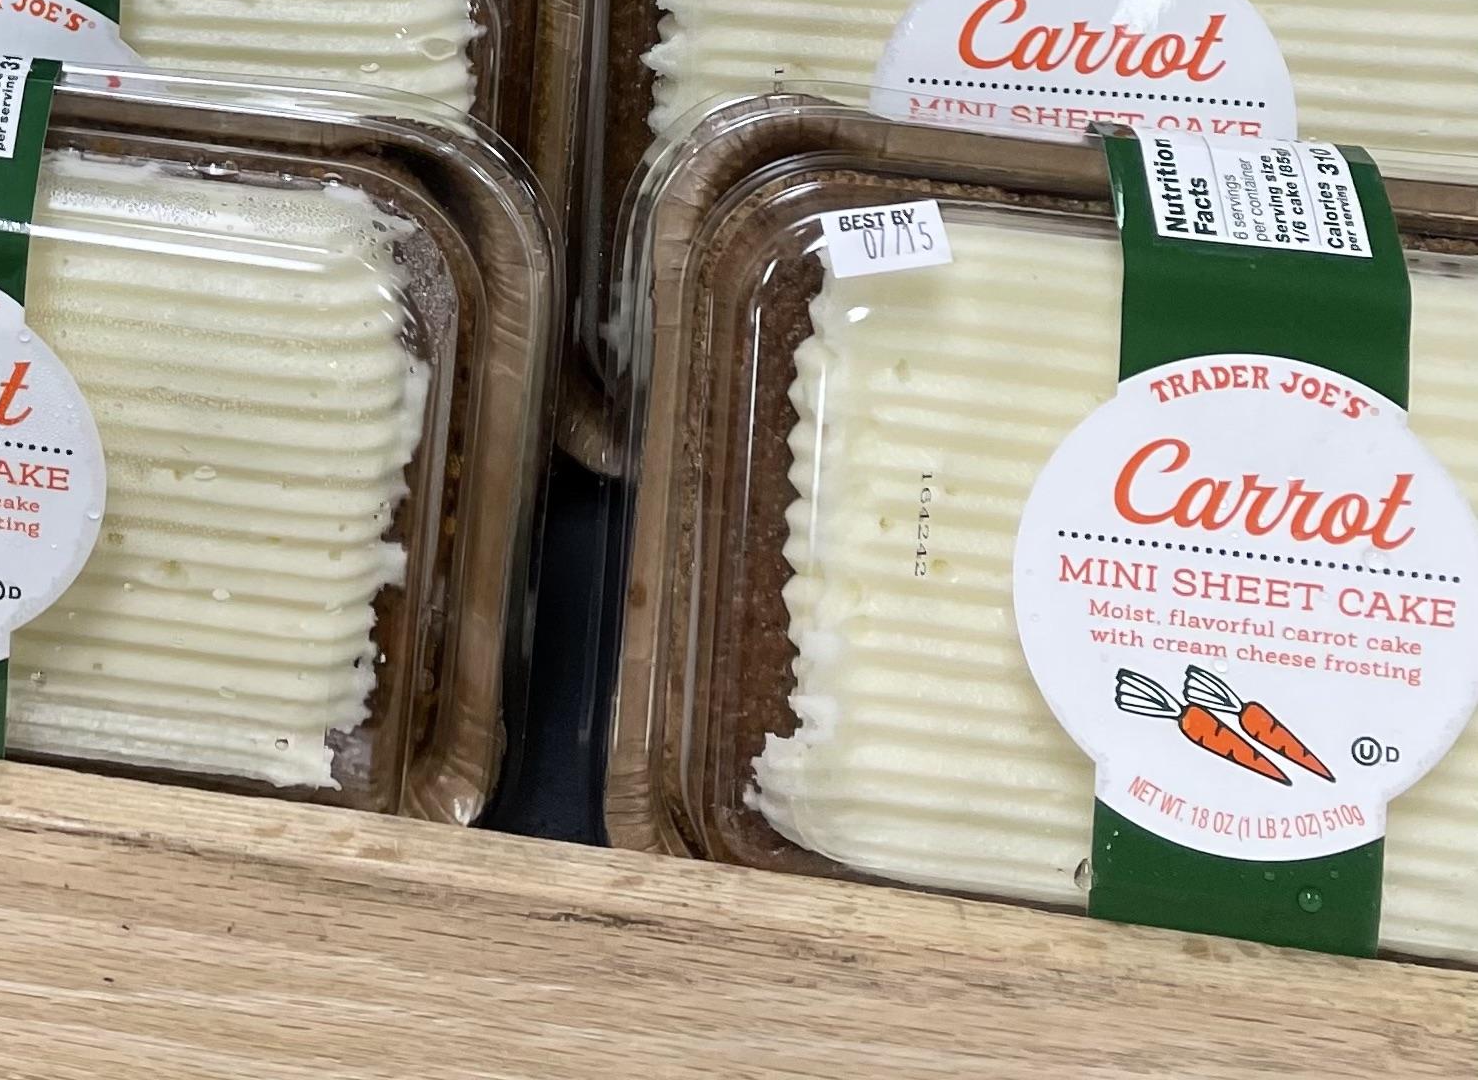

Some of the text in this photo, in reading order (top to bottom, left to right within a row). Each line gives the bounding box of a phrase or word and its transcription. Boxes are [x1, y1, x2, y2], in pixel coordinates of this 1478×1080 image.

[1155, 138, 1189, 234] Nutrition
[1190, 177, 1218, 237] Facts
[839, 208, 914, 232] BEST BY
[1150, 365, 1371, 420] TRADER JOE'S
[1113, 438, 1416, 550] Carrot
[1059, 554, 1457, 628] MINI SHEET CAKE
[1091, 627, 1421, 686] with cream cheese frosting
[1169, 609, 1274, 638] flavorful
[1282, 624, 1358, 649] carrot
[1366, 635, 1422, 656] cake
